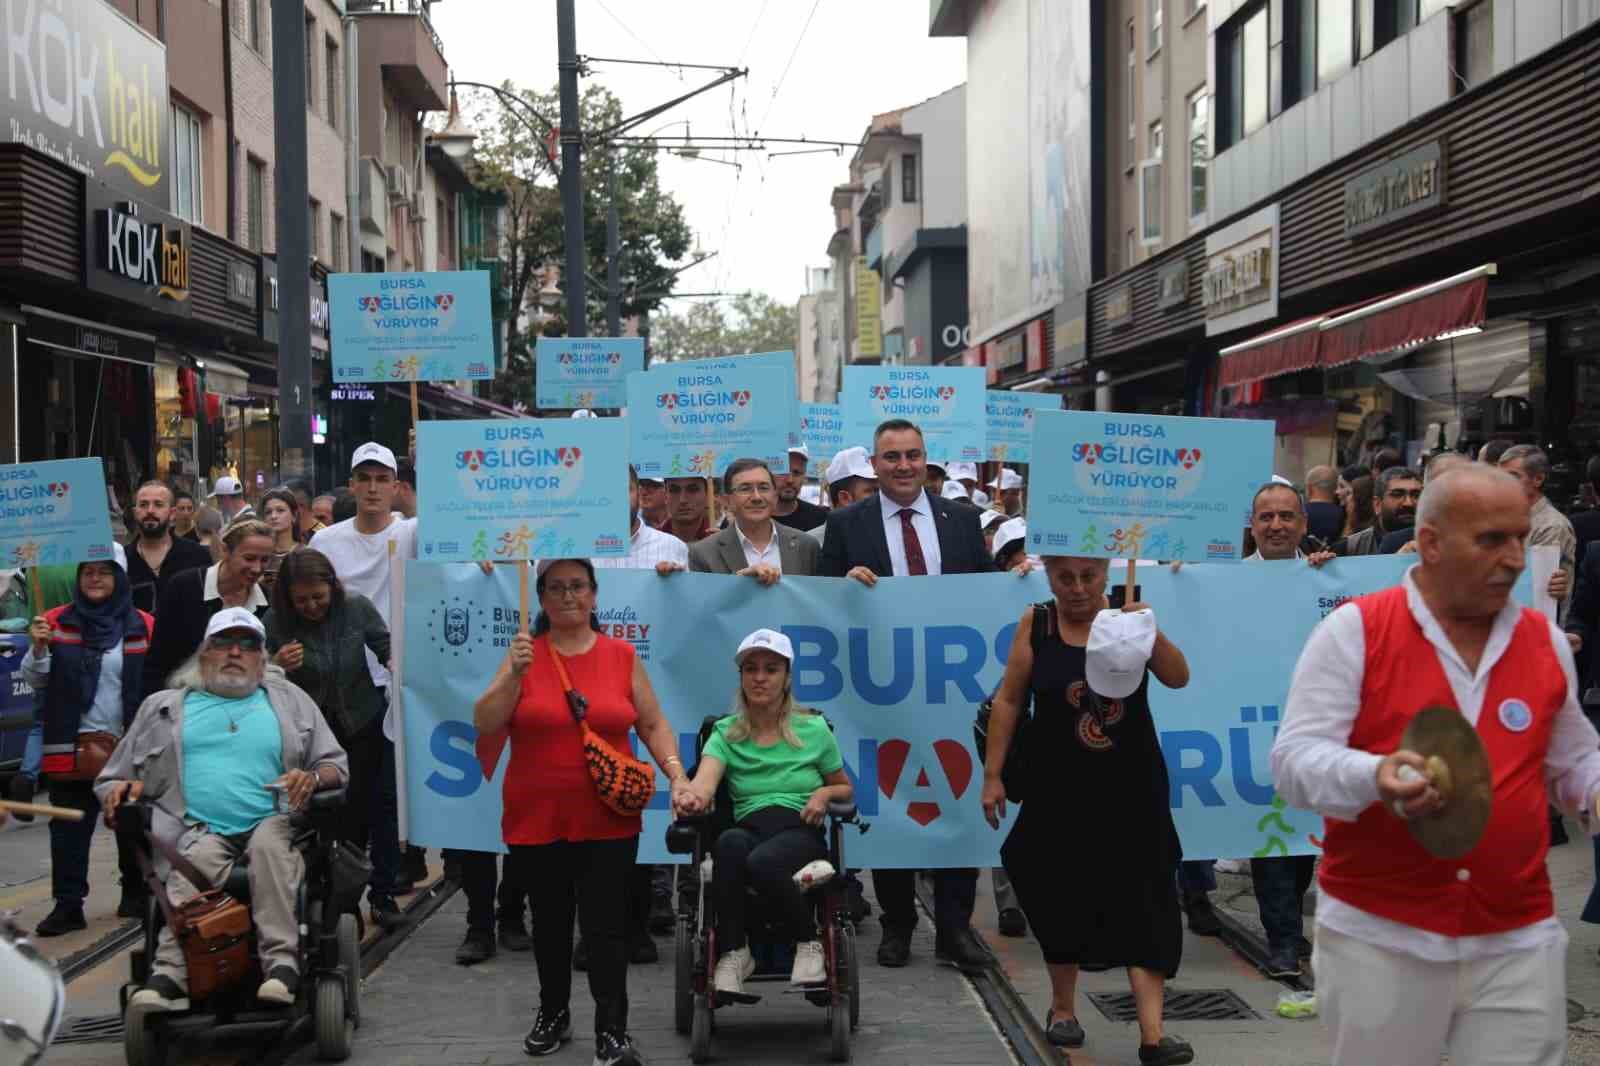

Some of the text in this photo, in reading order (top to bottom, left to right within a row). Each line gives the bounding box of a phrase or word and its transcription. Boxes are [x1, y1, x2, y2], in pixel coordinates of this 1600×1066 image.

[5, 0, 105, 149] KÖK
[108, 200, 158, 286] KÖK
[380, 279, 426, 289] BURSA
[358, 294, 454, 312] SAĞLIĞINA
[374, 316, 439, 329] YÜRÜYOR
[678, 375, 723, 387] BURSA
[888, 371, 930, 381] BURSA
[656, 390, 752, 410] SAĞLIĞINA
[869, 384, 955, 400] SAĞLIĞINA
[882, 404, 940, 415] YÜRÜYOR
[671, 412, 736, 425] YÜRÜYOR
[485, 426, 544, 441] BURSA
[1104, 423, 1166, 439] BURSA
[456, 445, 582, 471] SAĞLIĞINA
[1071, 440, 1201, 470] SAĞLIĞINA
[0, 469, 38, 481] URSA
[475, 475, 561, 491] YÜRÜYOR
[1090, 471, 1177, 489] YÜRÜYOR
[780, 622, 1021, 705] BUR
